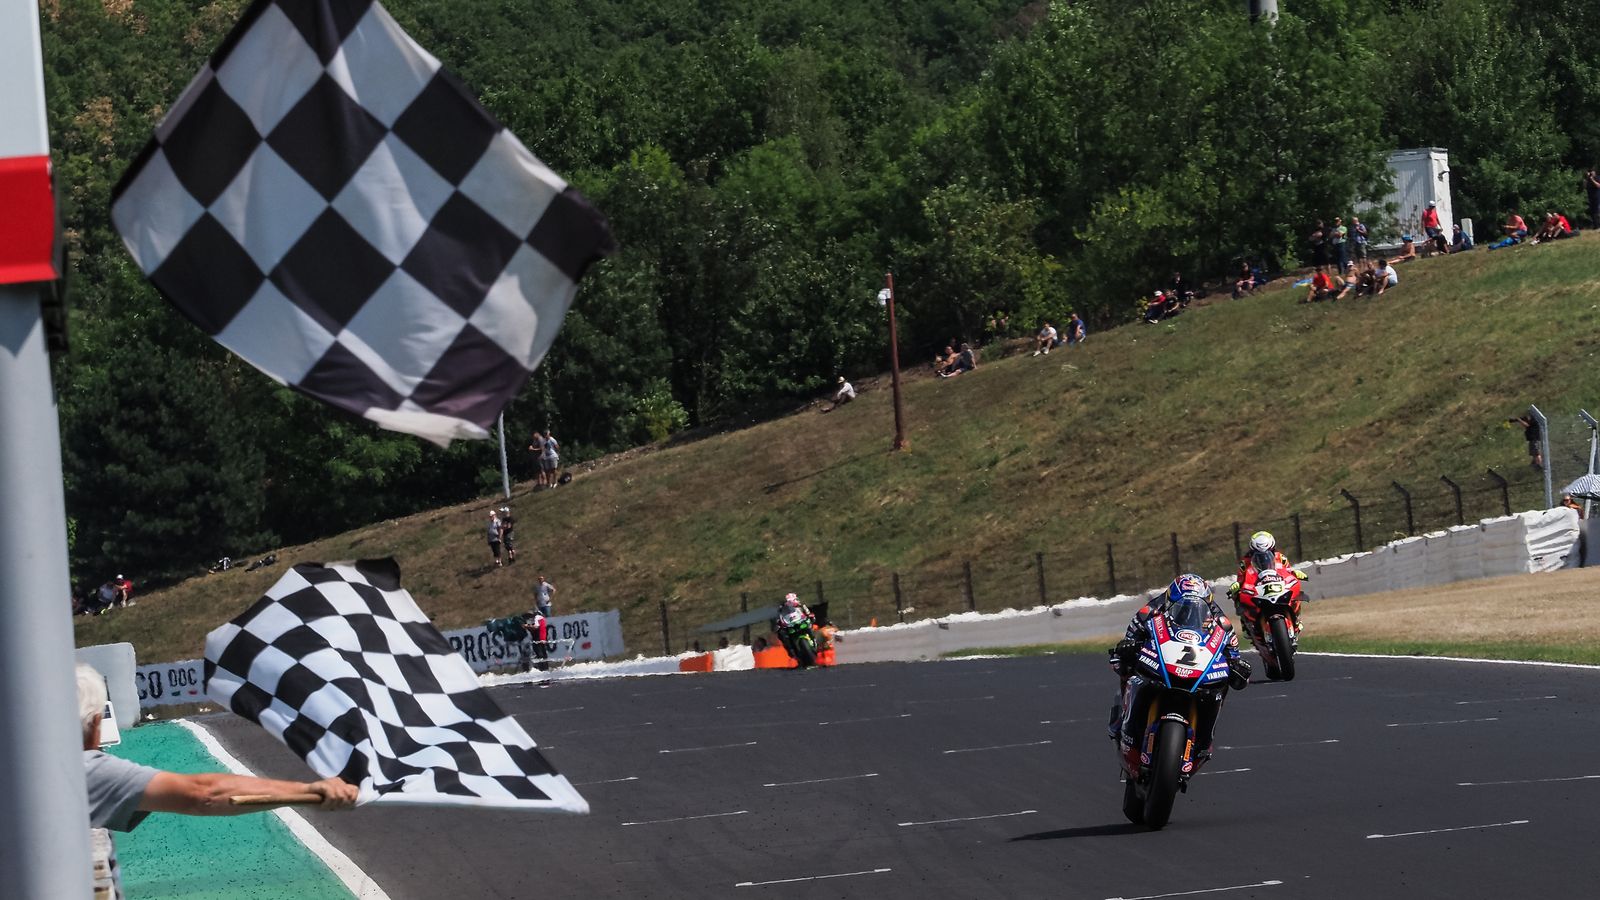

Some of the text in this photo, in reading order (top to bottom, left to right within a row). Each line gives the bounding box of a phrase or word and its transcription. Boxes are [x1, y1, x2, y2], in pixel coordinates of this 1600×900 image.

[450, 624, 556, 662] PROSEO
[1139, 655, 1159, 670] YAMAHA
[1207, 670, 1228, 680] YAMAHA
